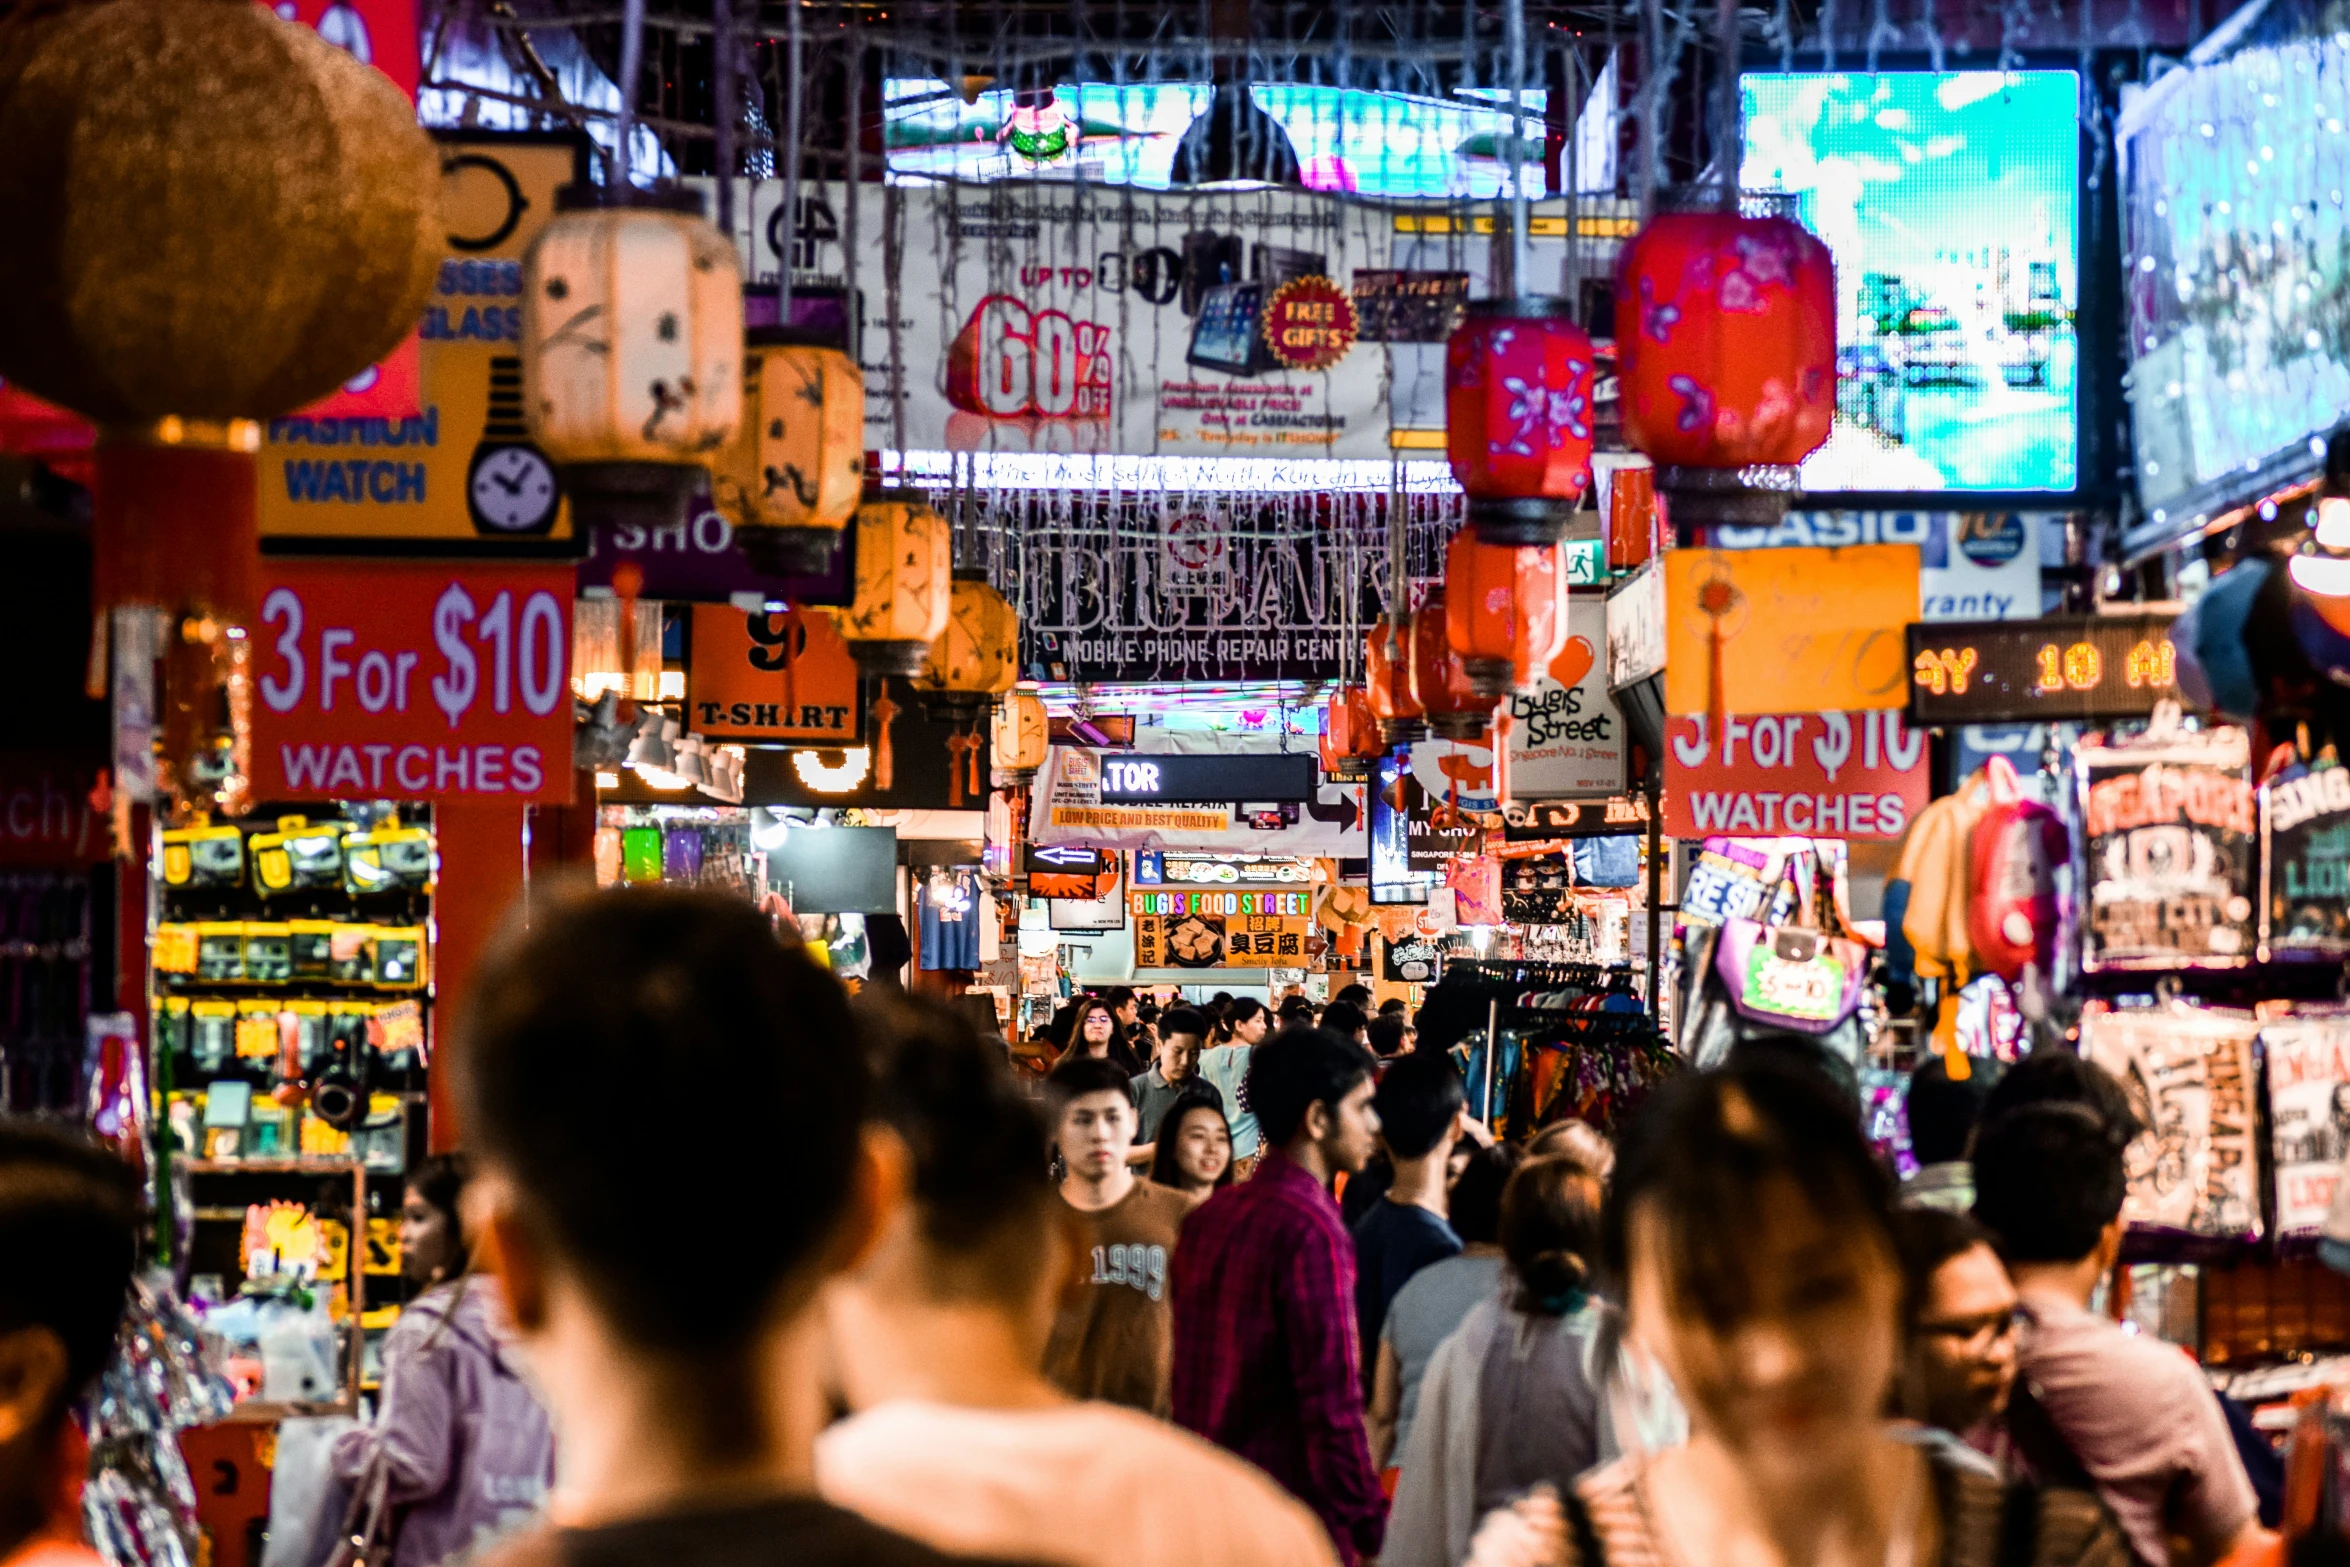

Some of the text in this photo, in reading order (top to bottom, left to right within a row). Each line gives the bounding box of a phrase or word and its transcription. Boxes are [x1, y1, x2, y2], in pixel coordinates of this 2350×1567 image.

[437, 258, 523, 296] SSES
[1020, 267, 1093, 289] UP TO
[284, 459, 427, 504] WATCH
[612, 510, 733, 553] SHO
[1923, 592, 2015, 620] ranty
[260, 581, 565, 729] 3 For $10
[1063, 640, 1137, 662] MOBILE
[1144, 641, 1208, 662] PHONE
[1216, 641, 1290, 662] REPAIR
[2036, 643, 2102, 690] 10
[1527, 711, 1611, 749] Street
[282, 745, 543, 792] WATCHES
[1060, 811, 1220, 829] LOW PRICE AND BEST QUALITY
[1689, 792, 1905, 835] WATCHES
[1409, 821, 1431, 836] MY
[1101, 857, 1119, 873] ki
[1133, 893, 1185, 915] BUGIS
[1191, 893, 1237, 915] FOOD
[1242, 893, 1308, 915] STREET
[1249, 916, 1280, 931] 招牌
[1230, 932, 1298, 955] 臭豆腐
[1242, 956, 1288, 965] Smelly Tofu
[1091, 1244, 1167, 1301] 1999
